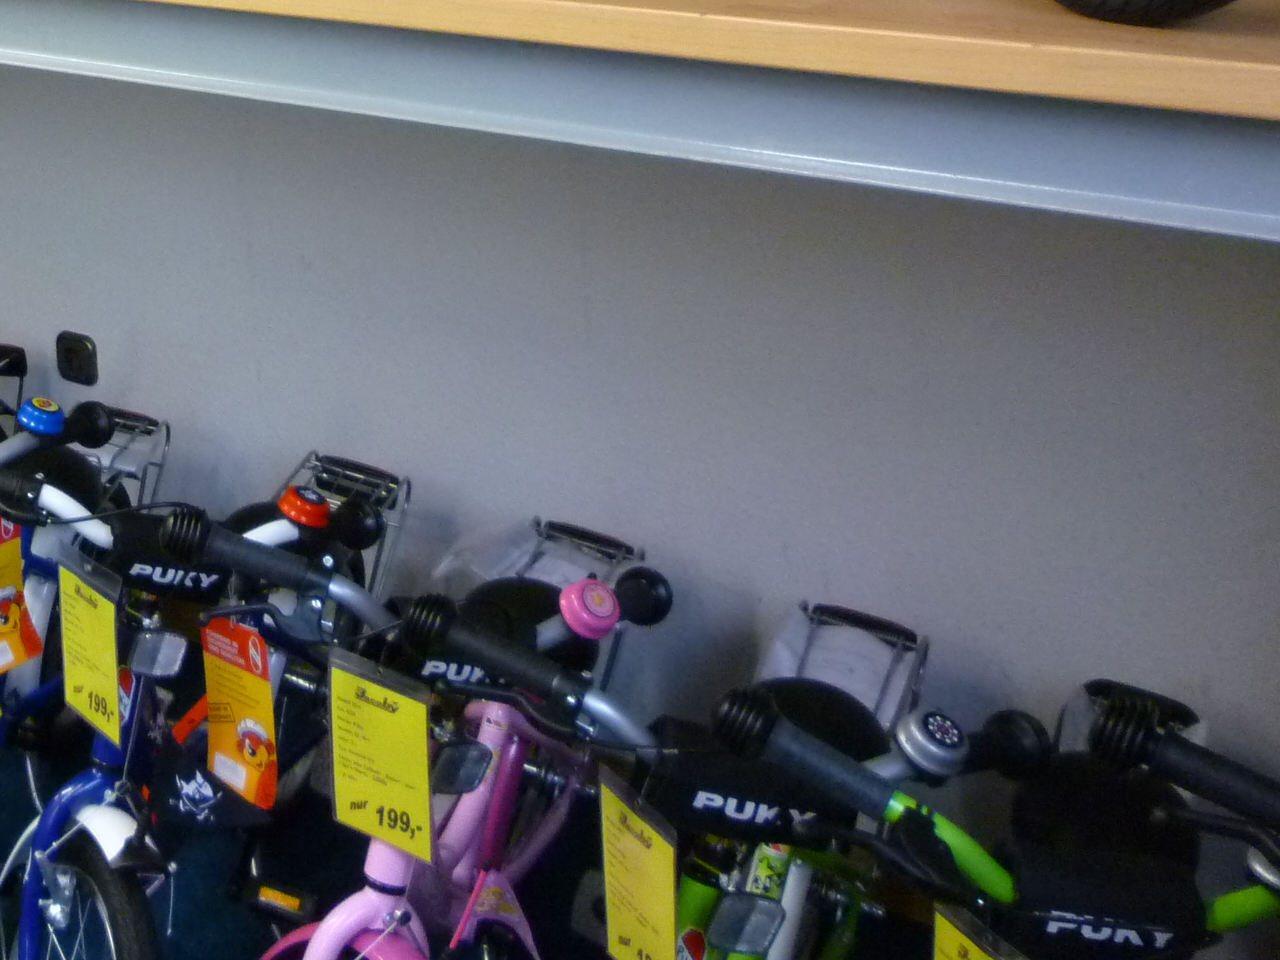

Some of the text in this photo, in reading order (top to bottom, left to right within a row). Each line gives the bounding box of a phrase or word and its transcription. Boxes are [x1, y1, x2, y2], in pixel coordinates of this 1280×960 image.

[129, 563, 220, 589] PUKY
[421, 659, 506, 684] PUK
[87, 691, 115, 724] 199,-
[349, 799, 423, 839] nur 199,-
[692, 790, 817, 831] PUKY
